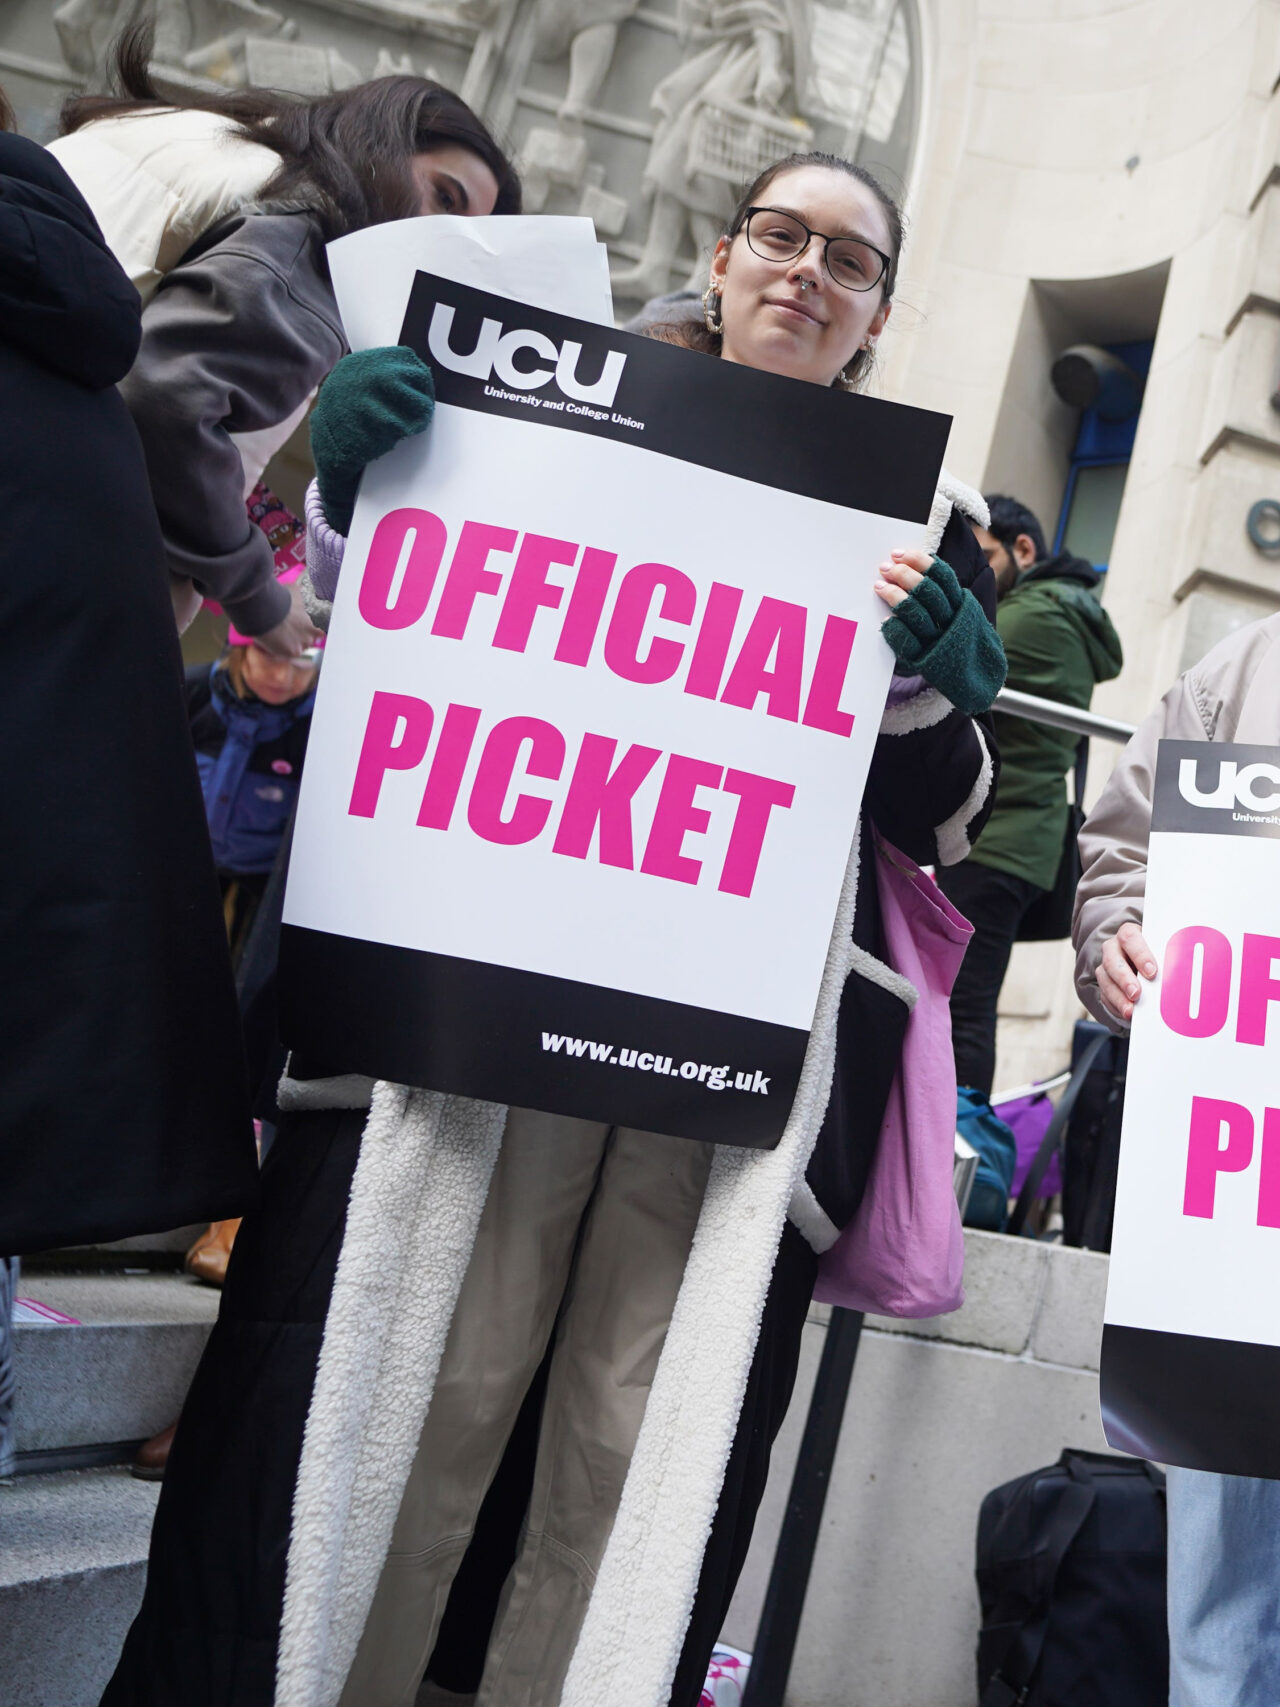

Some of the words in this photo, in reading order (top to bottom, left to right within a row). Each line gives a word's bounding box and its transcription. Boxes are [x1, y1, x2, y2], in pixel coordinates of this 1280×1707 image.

[428, 302, 627, 408] UCU
[484, 385, 543, 408] University
[543, 399, 565, 412] and
[566, 403, 609, 421] College
[611, 412, 645, 430] Union
[357, 507, 859, 738] OFFICIAL
[348, 690, 796, 899] PICKET
[541, 1031, 771, 1096] www.ucu.org.uk
